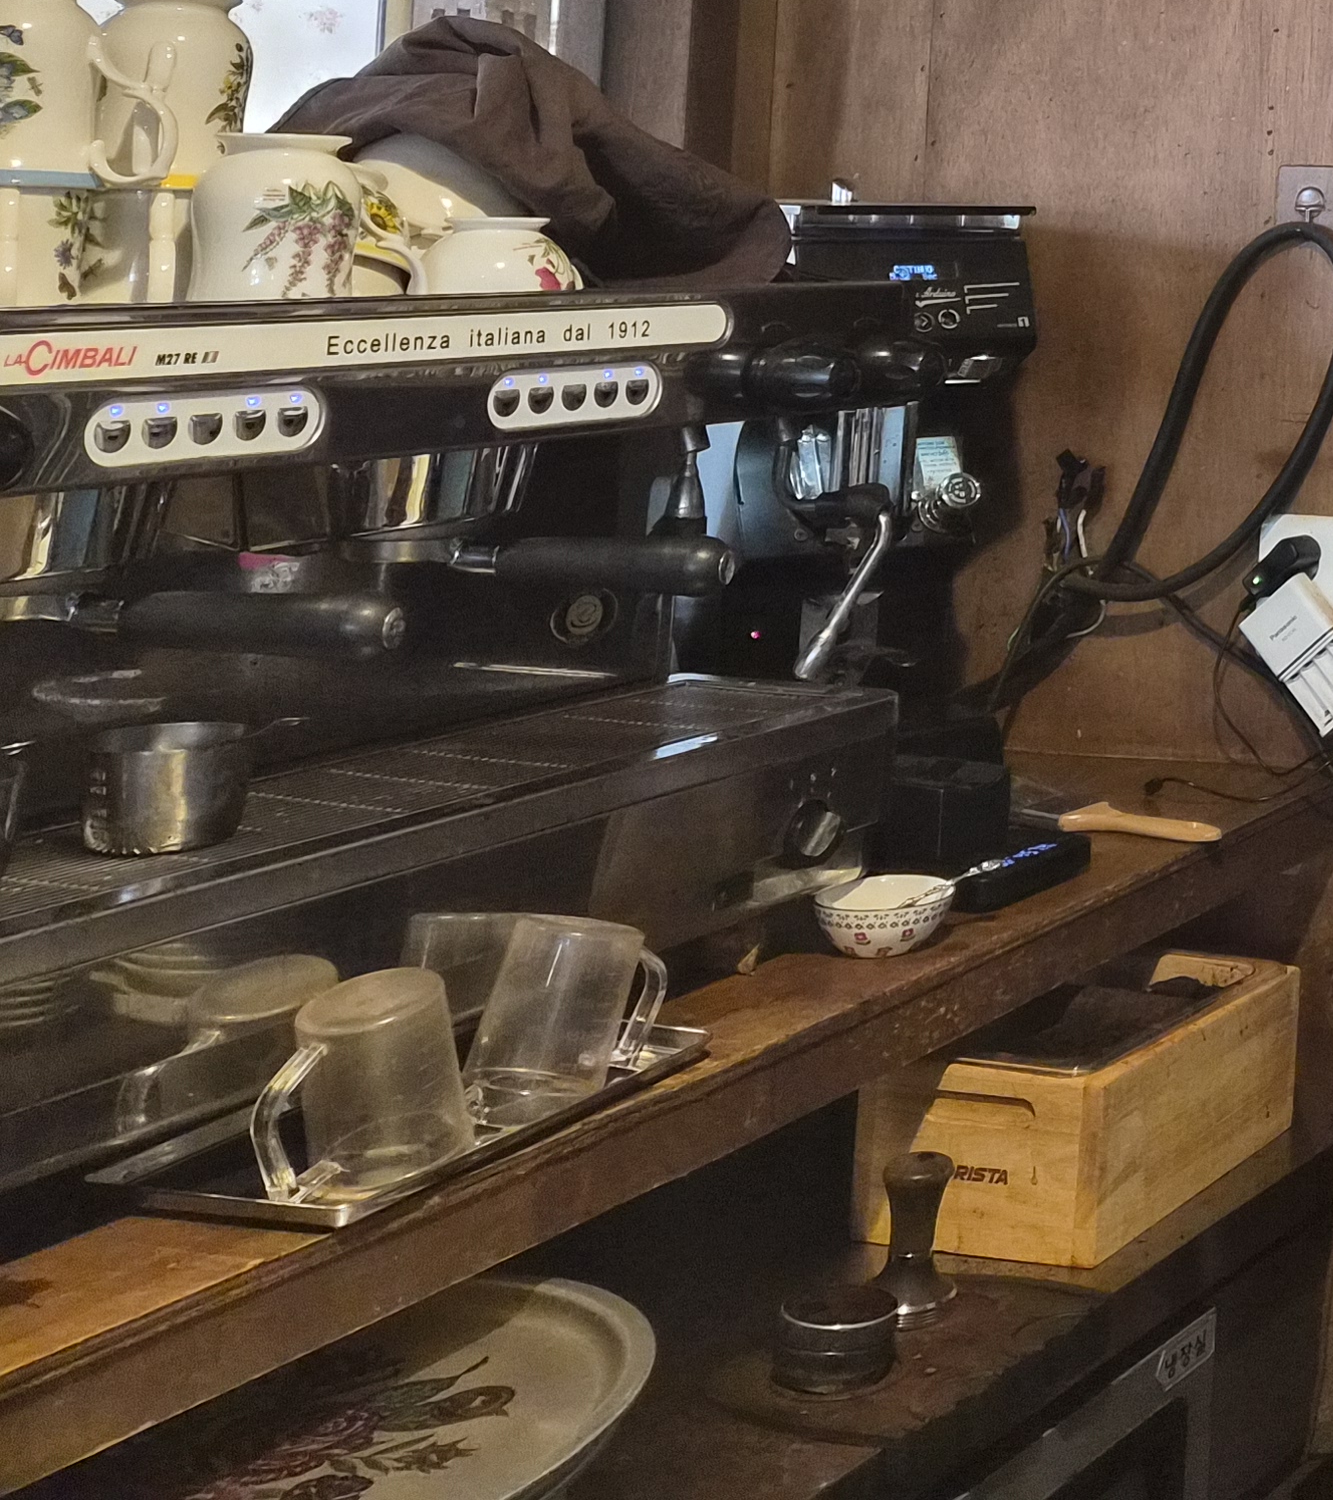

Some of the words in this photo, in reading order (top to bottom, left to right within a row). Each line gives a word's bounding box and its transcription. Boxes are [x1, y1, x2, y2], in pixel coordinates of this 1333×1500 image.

[326, 332, 452, 357] Eccellenza
[469, 326, 547, 349] italiana
[562, 323, 592, 344] dal
[607, 319, 652, 340] 1912
[155, 353, 181, 367] M27
[183, 351, 199, 365] RE
[953, 1164, 1008, 1186] RISTA
